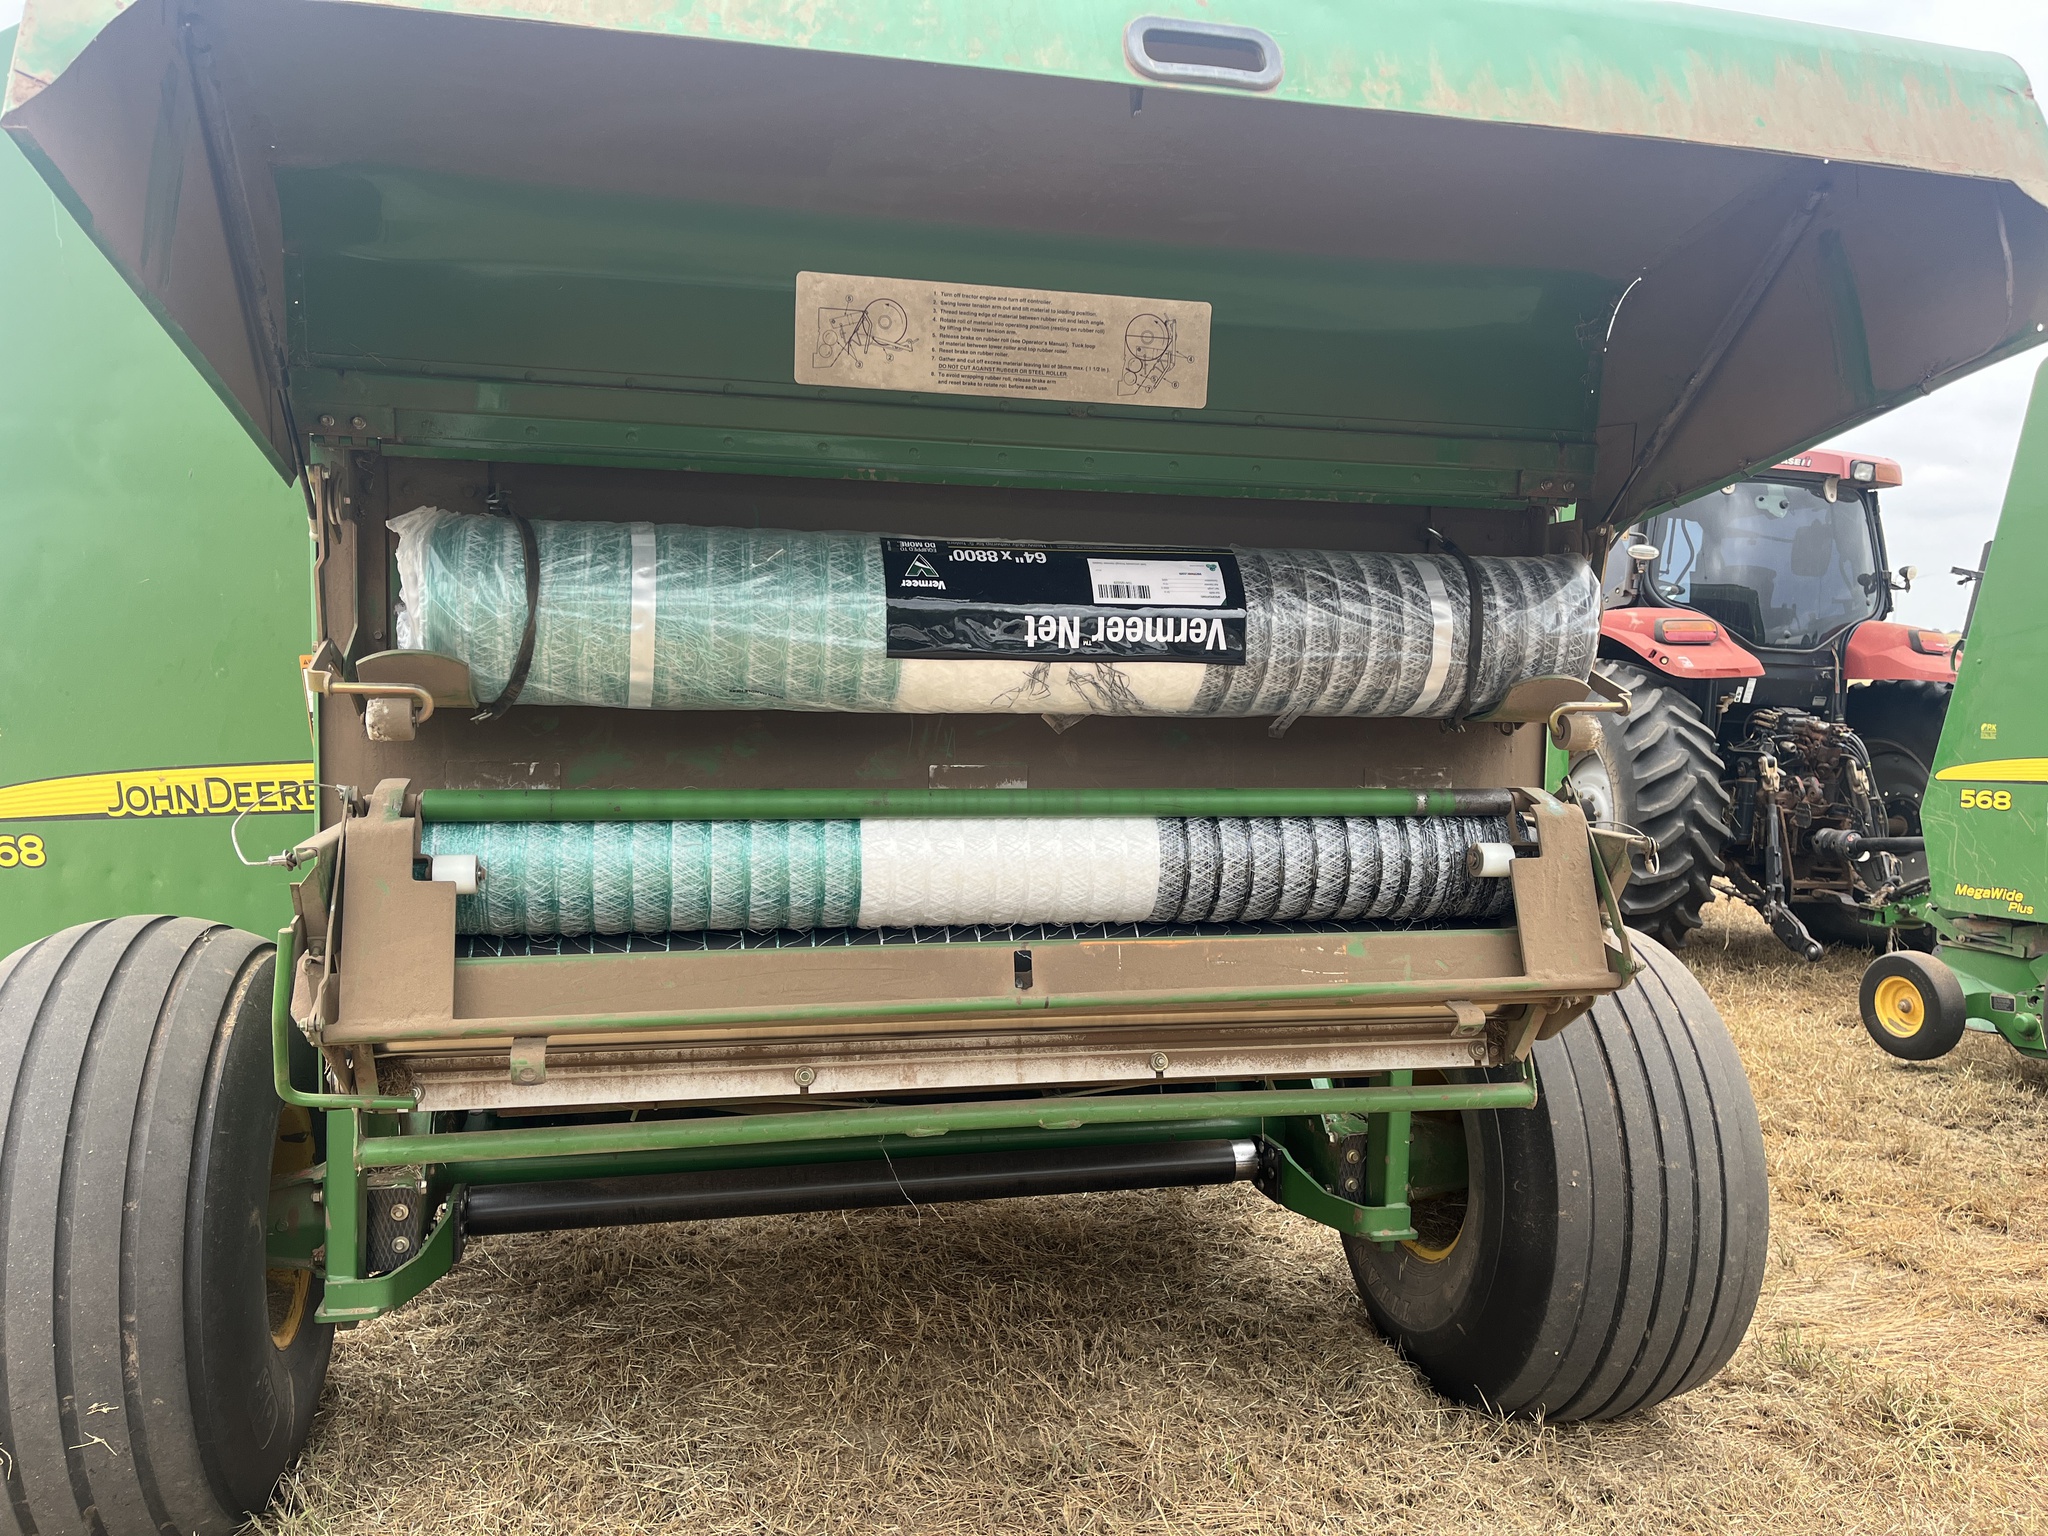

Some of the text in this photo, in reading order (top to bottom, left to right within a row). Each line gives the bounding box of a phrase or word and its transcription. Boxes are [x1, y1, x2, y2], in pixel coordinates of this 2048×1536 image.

[1781, 457, 1801, 466] ASE
[1002, 552, 1012, 562] x
[1014, 550, 1048, 564] 64"
[900, 579, 946, 590] Vermeer
[1024, 614, 1080, 649] Net
[107, 777, 314, 817] JOHN DEERE
[1960, 788, 2012, 812] 568
[1954, 882, 2024, 902] MegaWide
[2008, 900, 2034, 915] Plus
